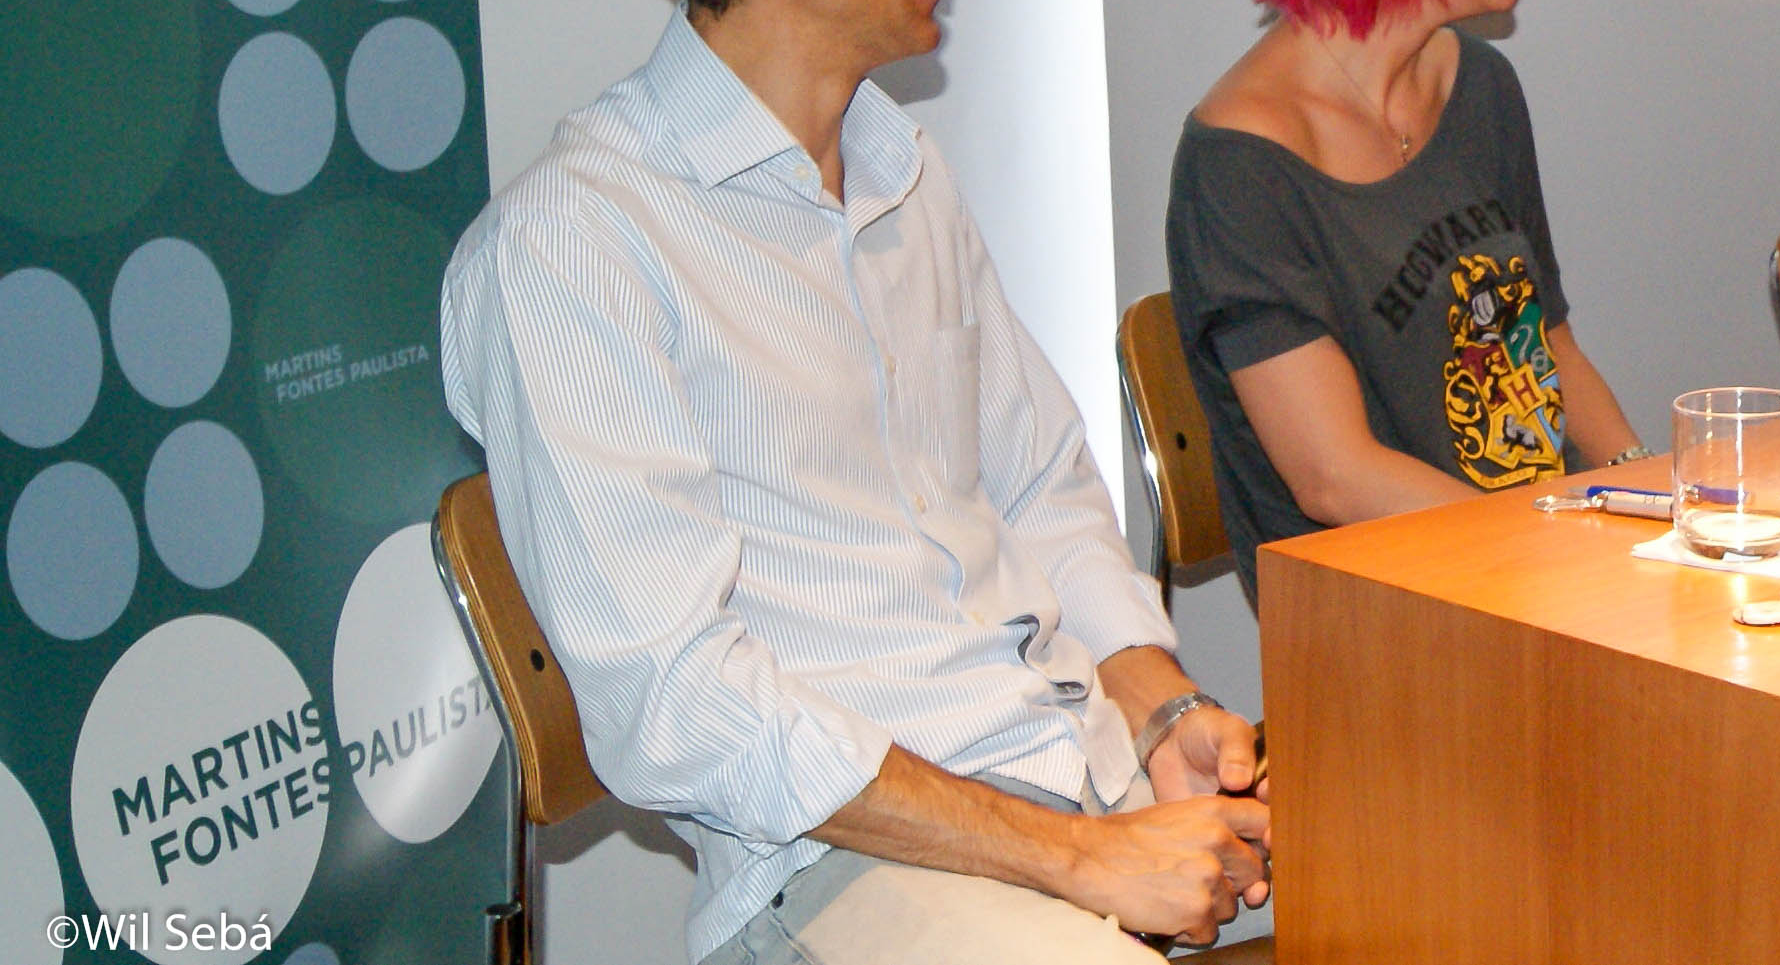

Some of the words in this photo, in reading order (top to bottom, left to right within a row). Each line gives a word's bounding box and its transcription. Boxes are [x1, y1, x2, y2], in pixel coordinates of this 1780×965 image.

[264, 344, 342, 383] MARTINS
[276, 368, 345, 403] FONTES
[350, 344, 429, 383] PAULISTA
[112, 700, 324, 837] MARTINS
[151, 760, 332, 885] FONTES
[344, 676, 492, 778] PAULIST
